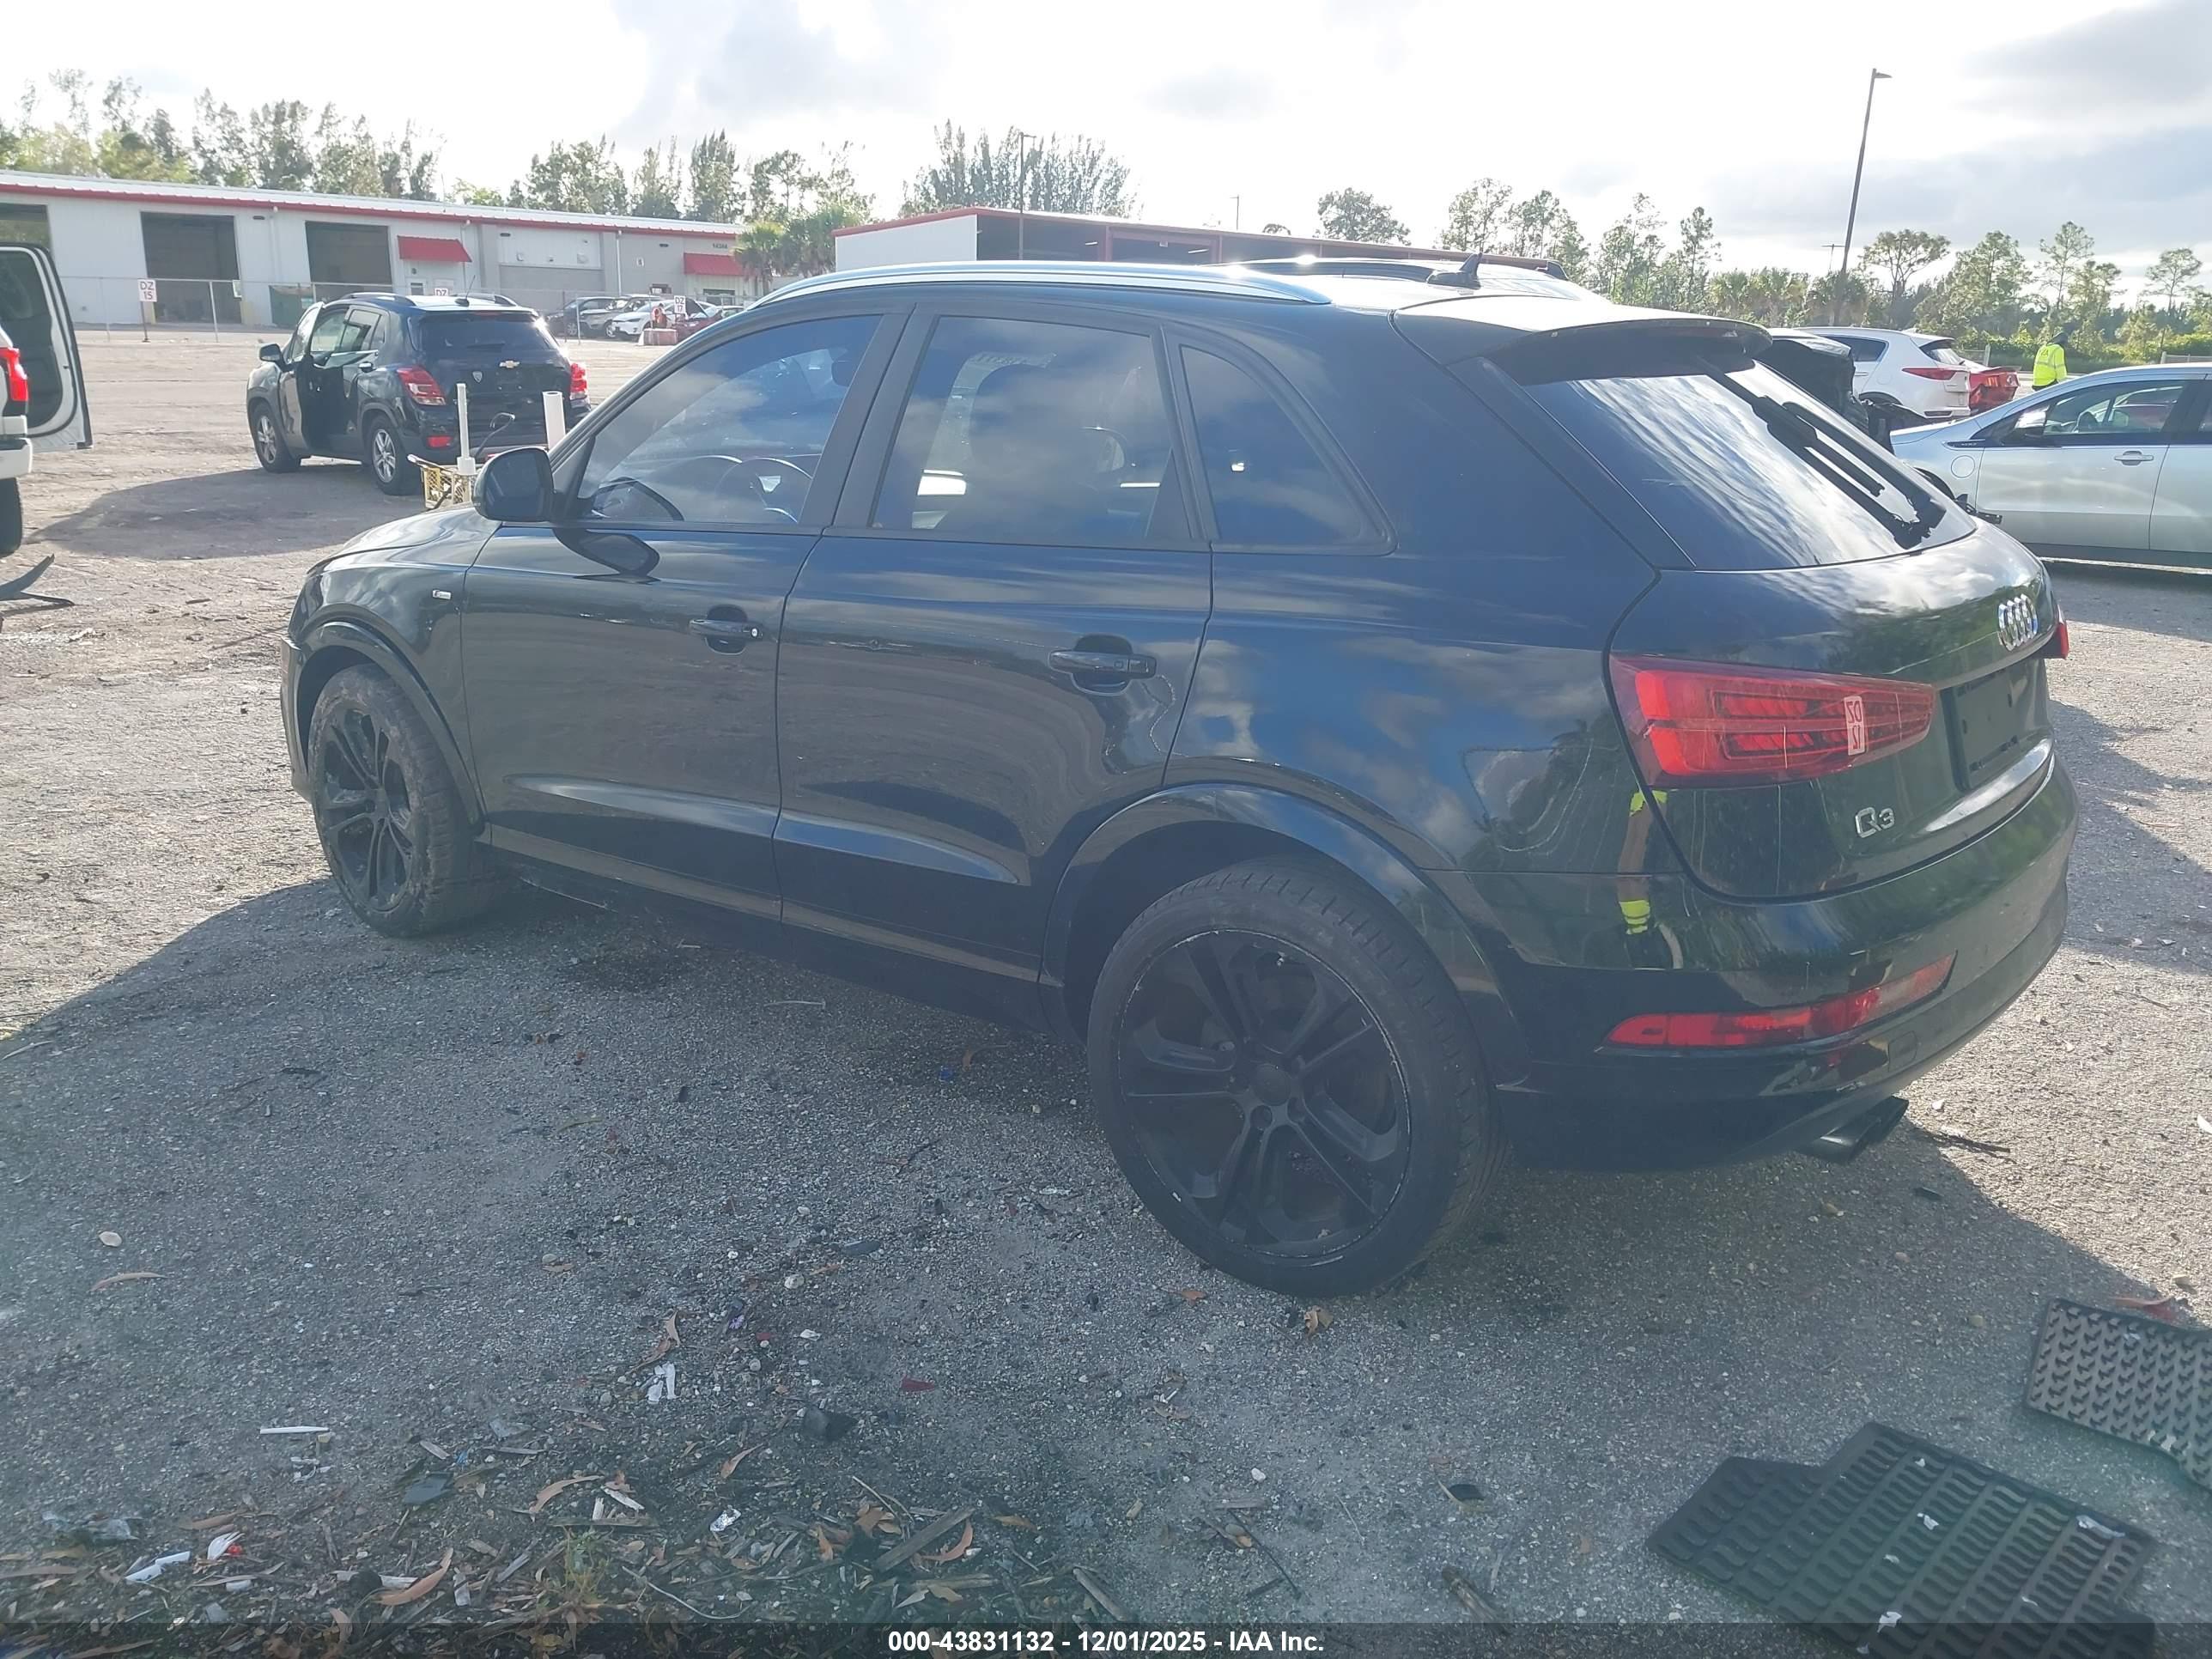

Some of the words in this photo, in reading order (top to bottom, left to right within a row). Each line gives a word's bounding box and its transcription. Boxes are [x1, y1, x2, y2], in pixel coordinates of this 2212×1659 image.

[140, 281, 155, 290] DZ
[143, 290, 153, 300] 15
[1855, 806, 1895, 838] Q3
